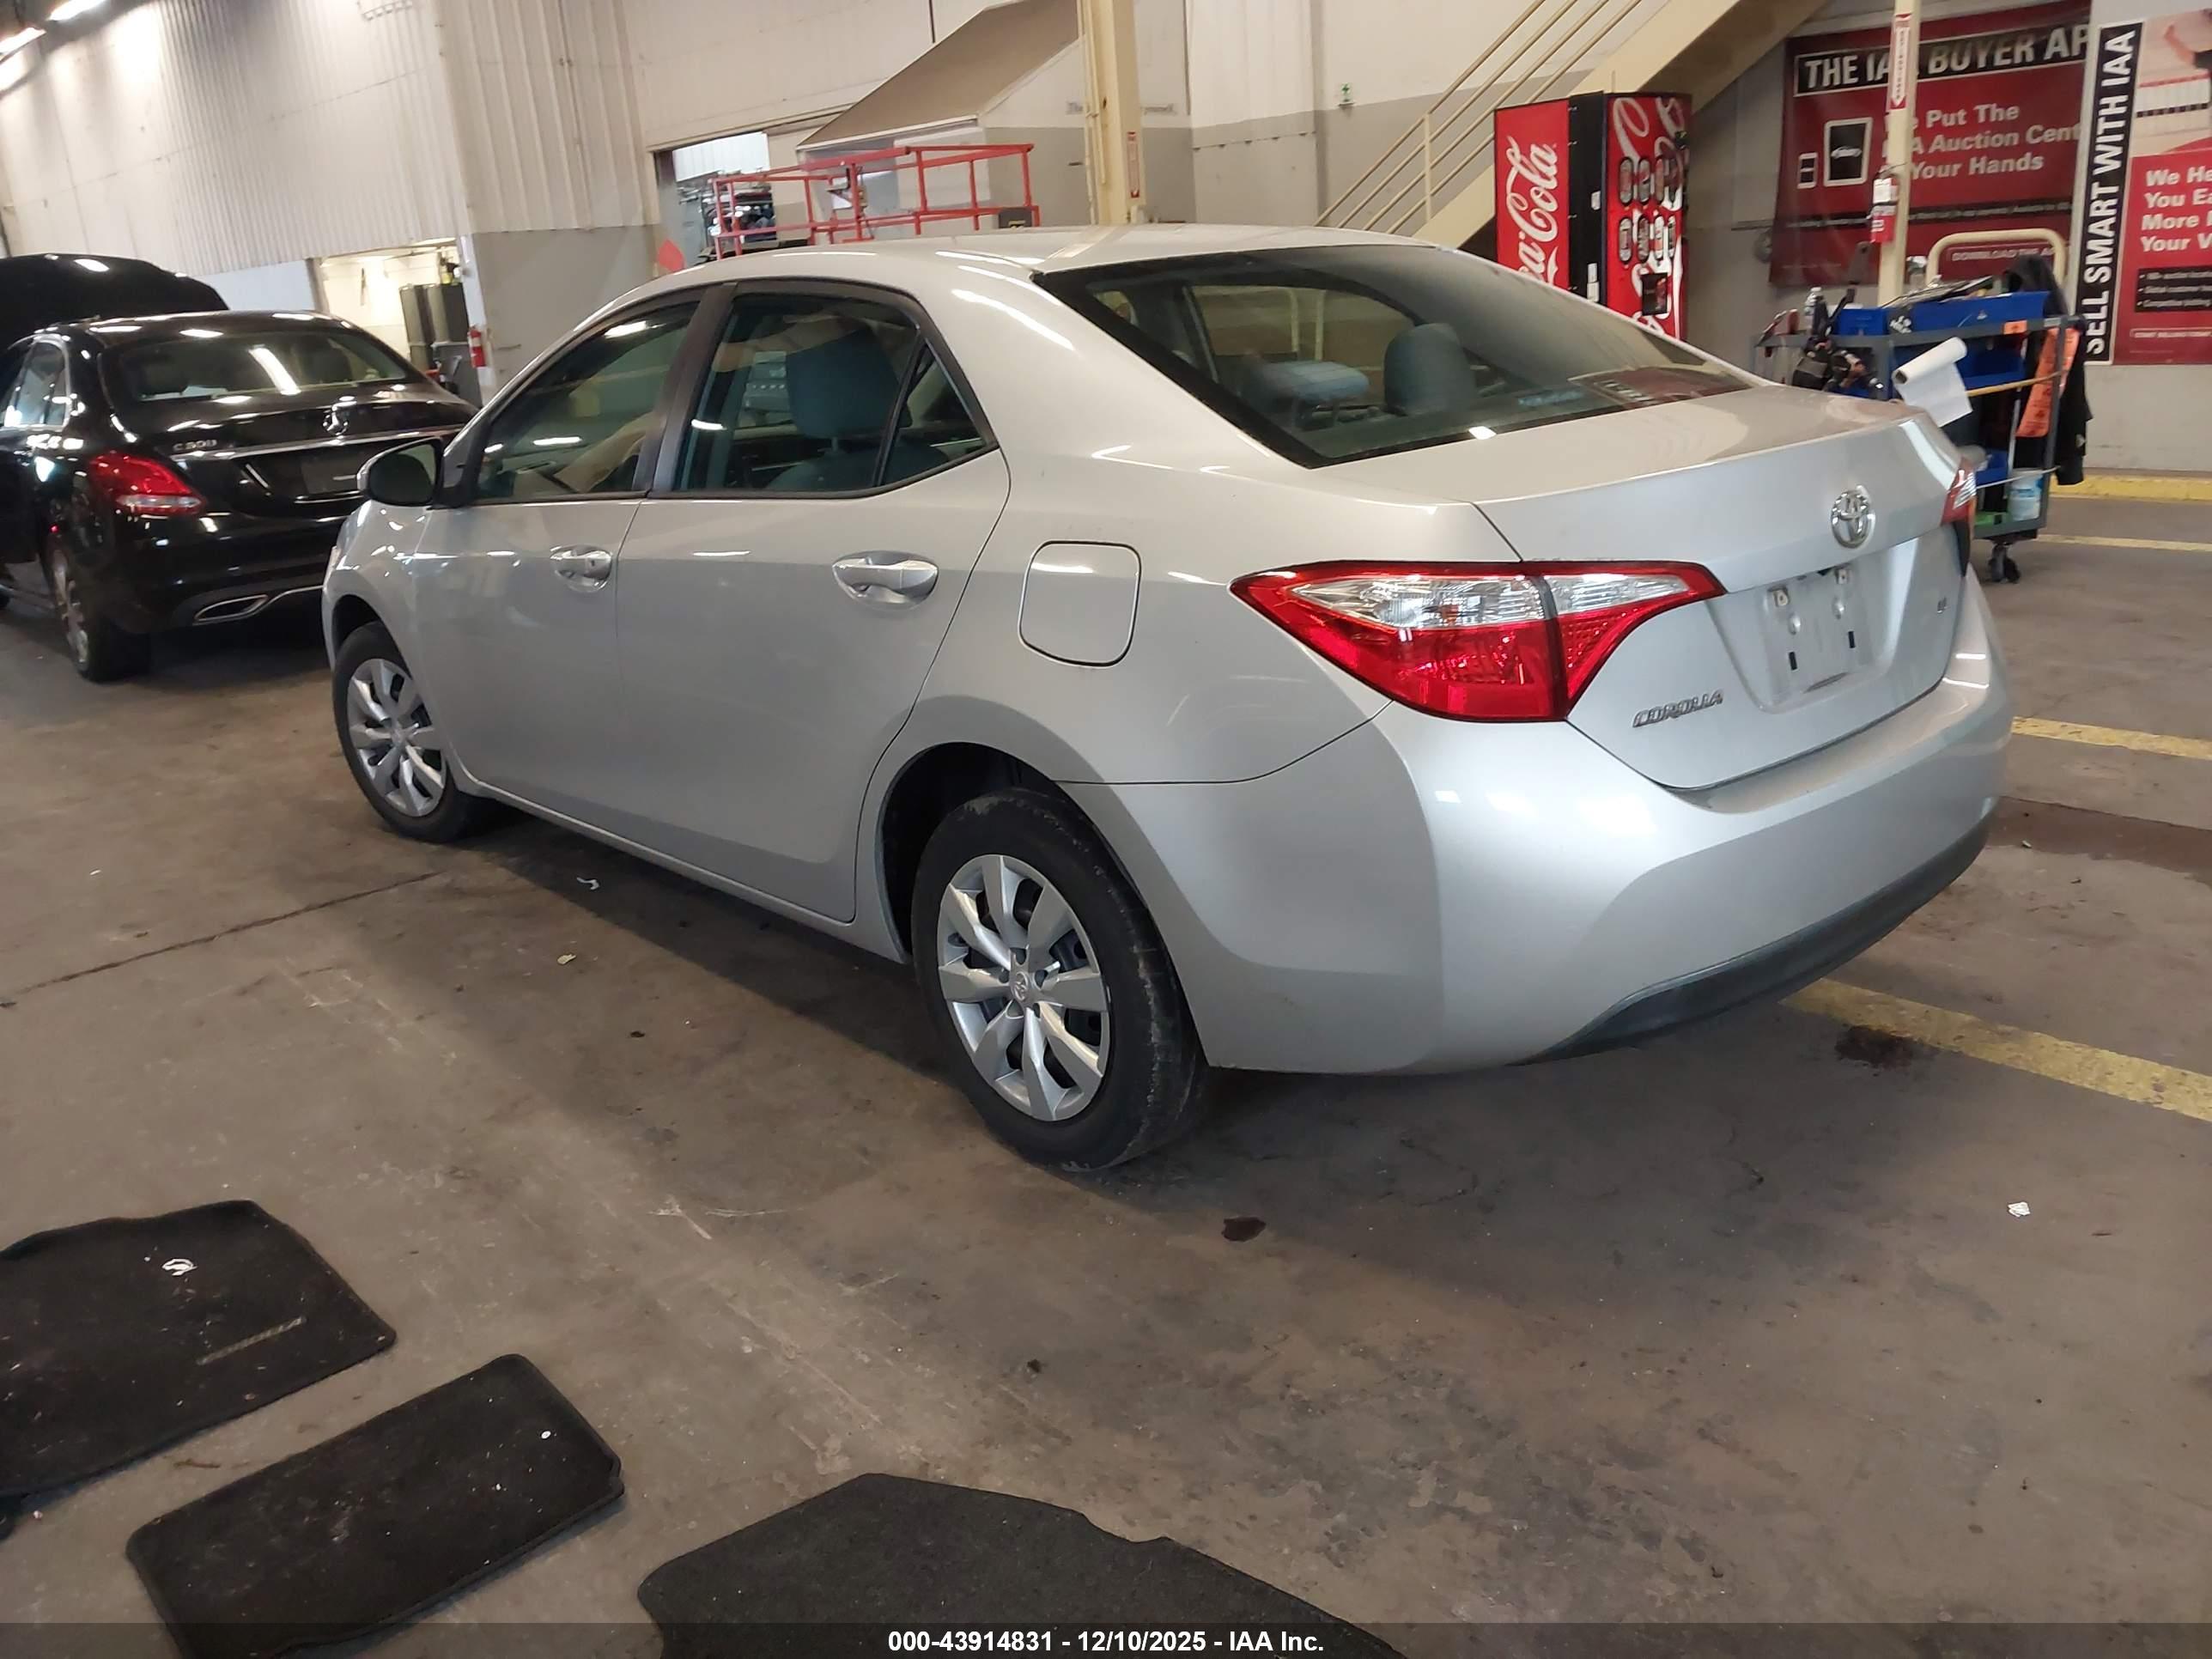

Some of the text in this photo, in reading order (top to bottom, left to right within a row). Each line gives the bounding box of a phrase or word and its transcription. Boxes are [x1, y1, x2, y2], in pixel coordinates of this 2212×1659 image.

[1805, 54, 1859, 88] THE
[1928, 35, 2035, 76] BUYER
[1925, 109, 1967, 128] Put
[1973, 103, 2020, 124] The
[1929, 130, 2020, 154] Auction
[1911, 161, 1964, 180] Your
[1968, 151, 2045, 175] Hands
[2146, 168, 2180, 186] We
[2081, 30, 2136, 355] SELL SMART WITH IAA
[2144, 191, 2186, 209] You
[2141, 213, 2200, 231] More
[2140, 235, 2191, 252] Your
[1632, 688, 1724, 728] COROLLA
